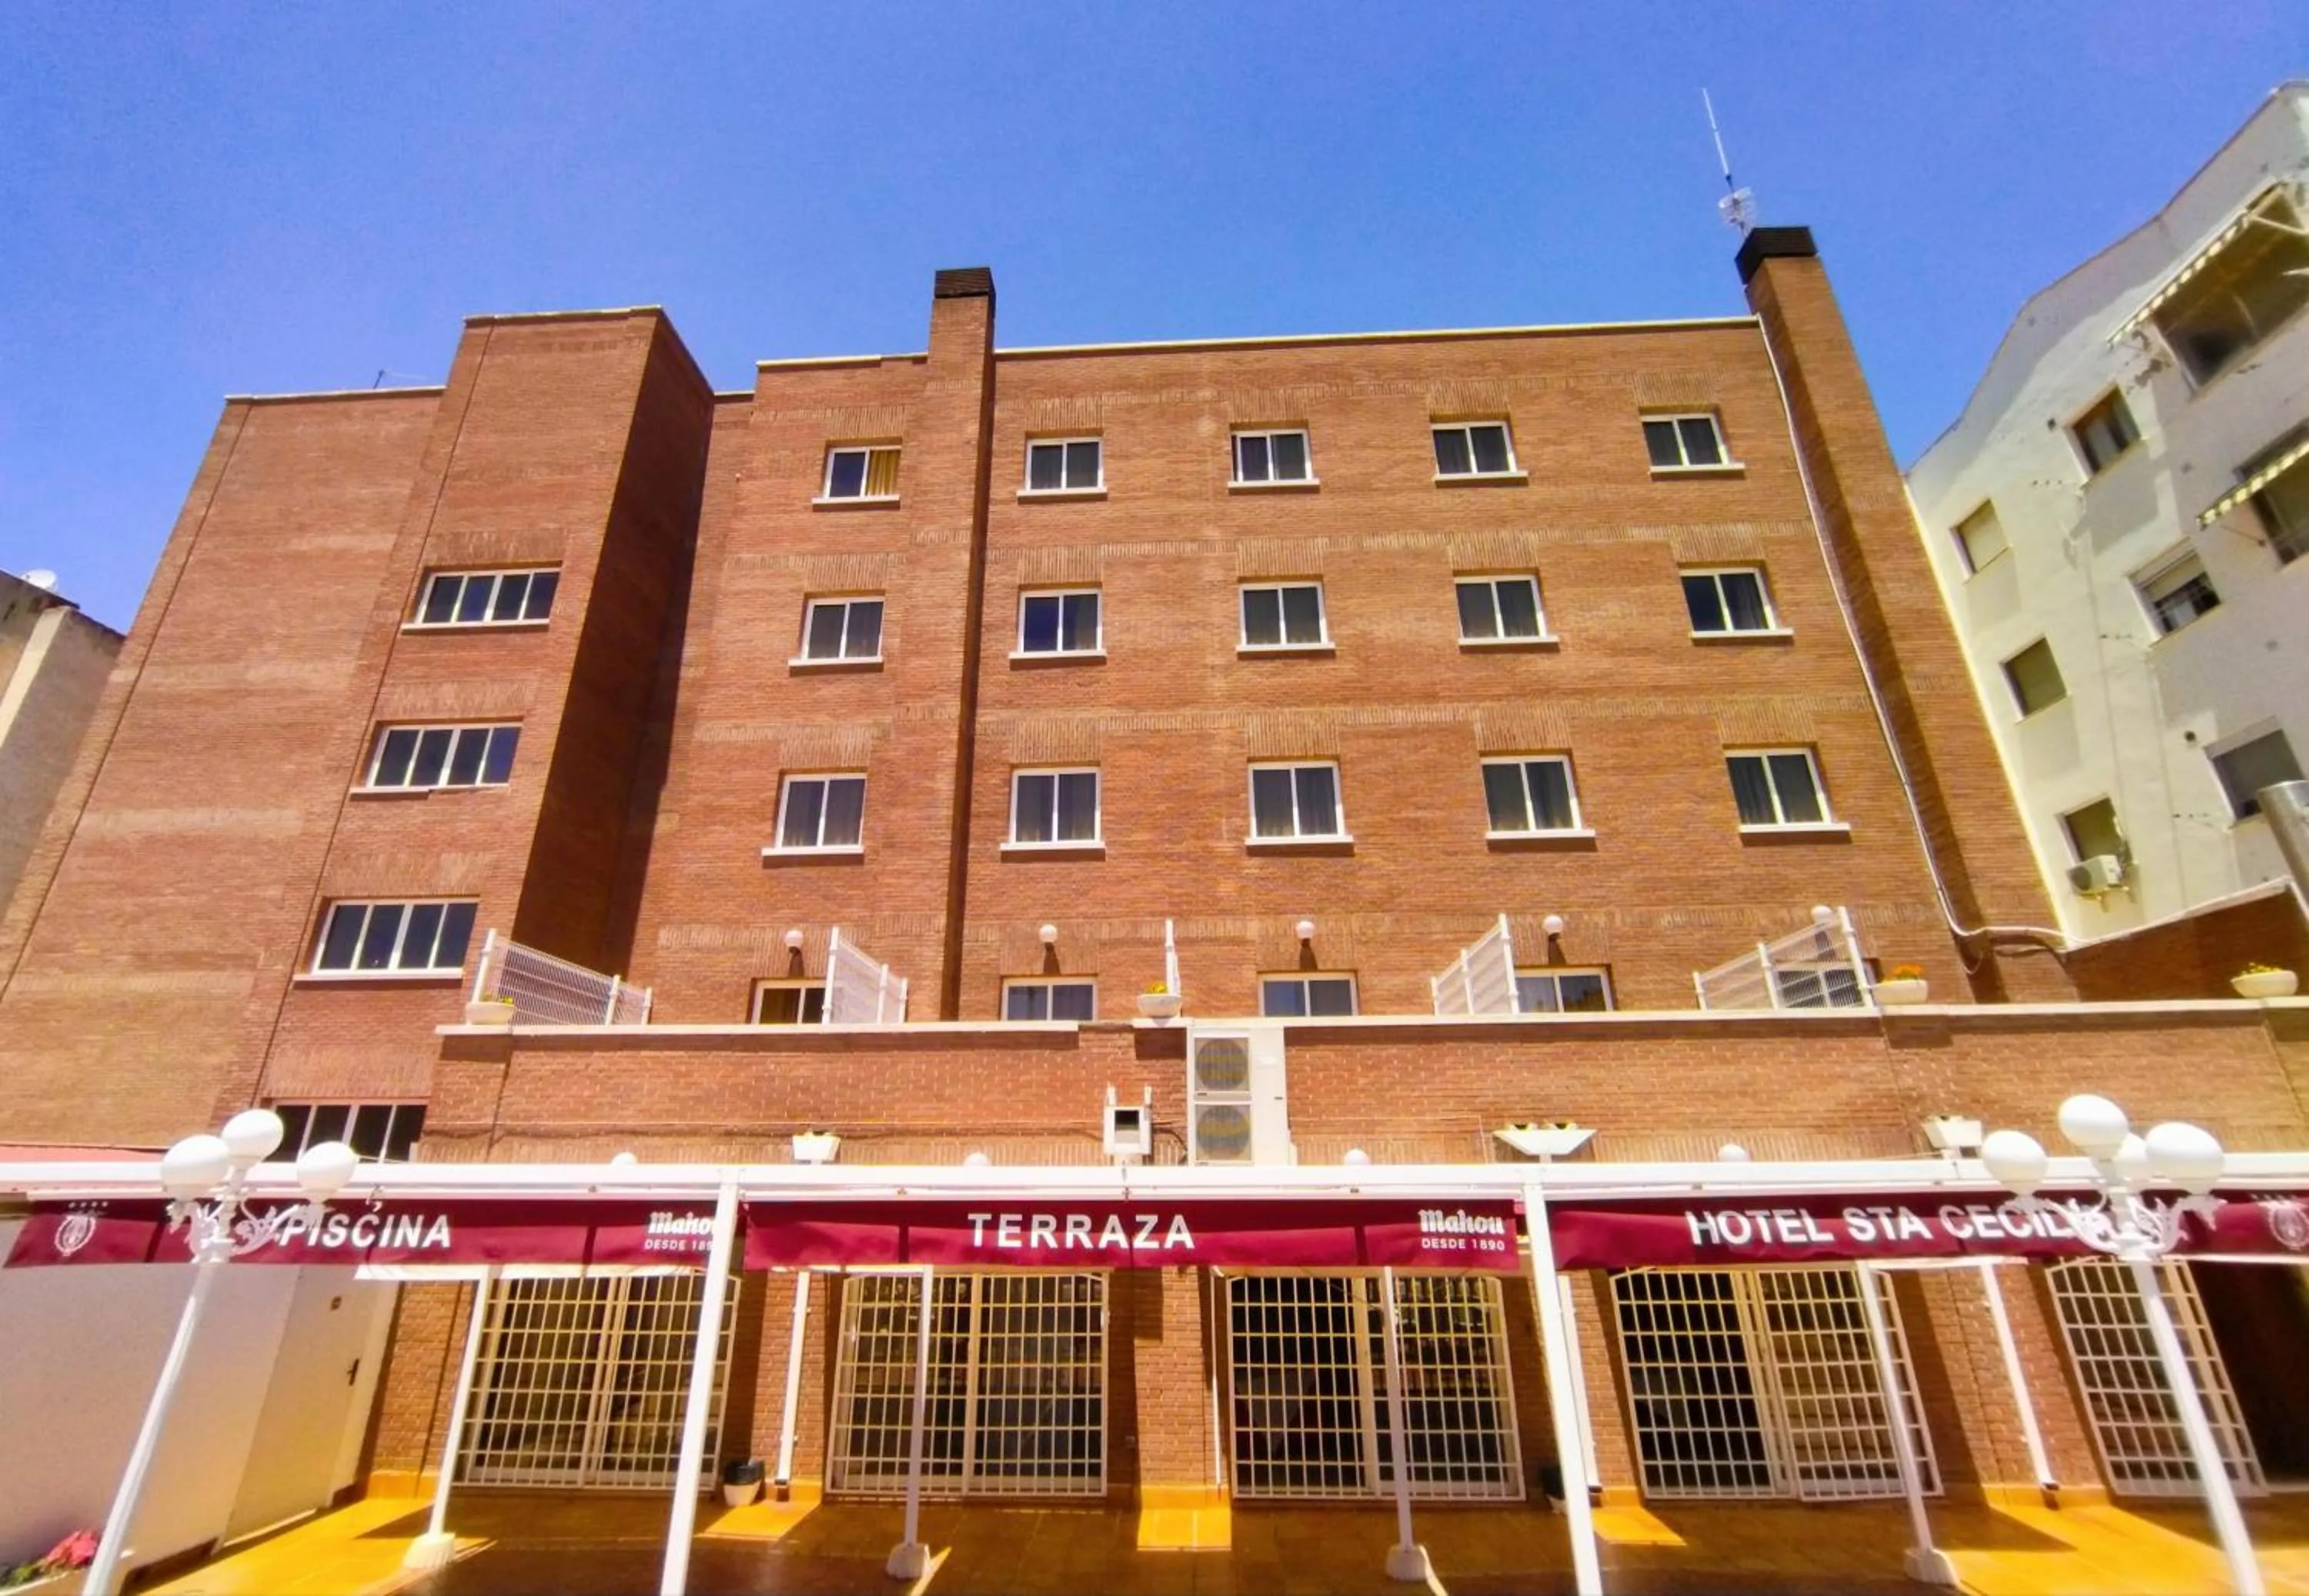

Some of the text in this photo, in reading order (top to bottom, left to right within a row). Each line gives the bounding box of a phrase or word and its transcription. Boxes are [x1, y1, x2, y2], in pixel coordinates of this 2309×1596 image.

[279, 1213, 451, 1247] PISCINA
[648, 1211, 713, 1235] Maho
[967, 1213, 1195, 1249] TERRAZA
[1418, 1209, 1505, 1234] Mahou
[1685, 1204, 2080, 1245] HOTEL STA CECIL
[644, 1238, 714, 1251] DESDE 189
[1421, 1237, 1505, 1250] DESDE 1890
